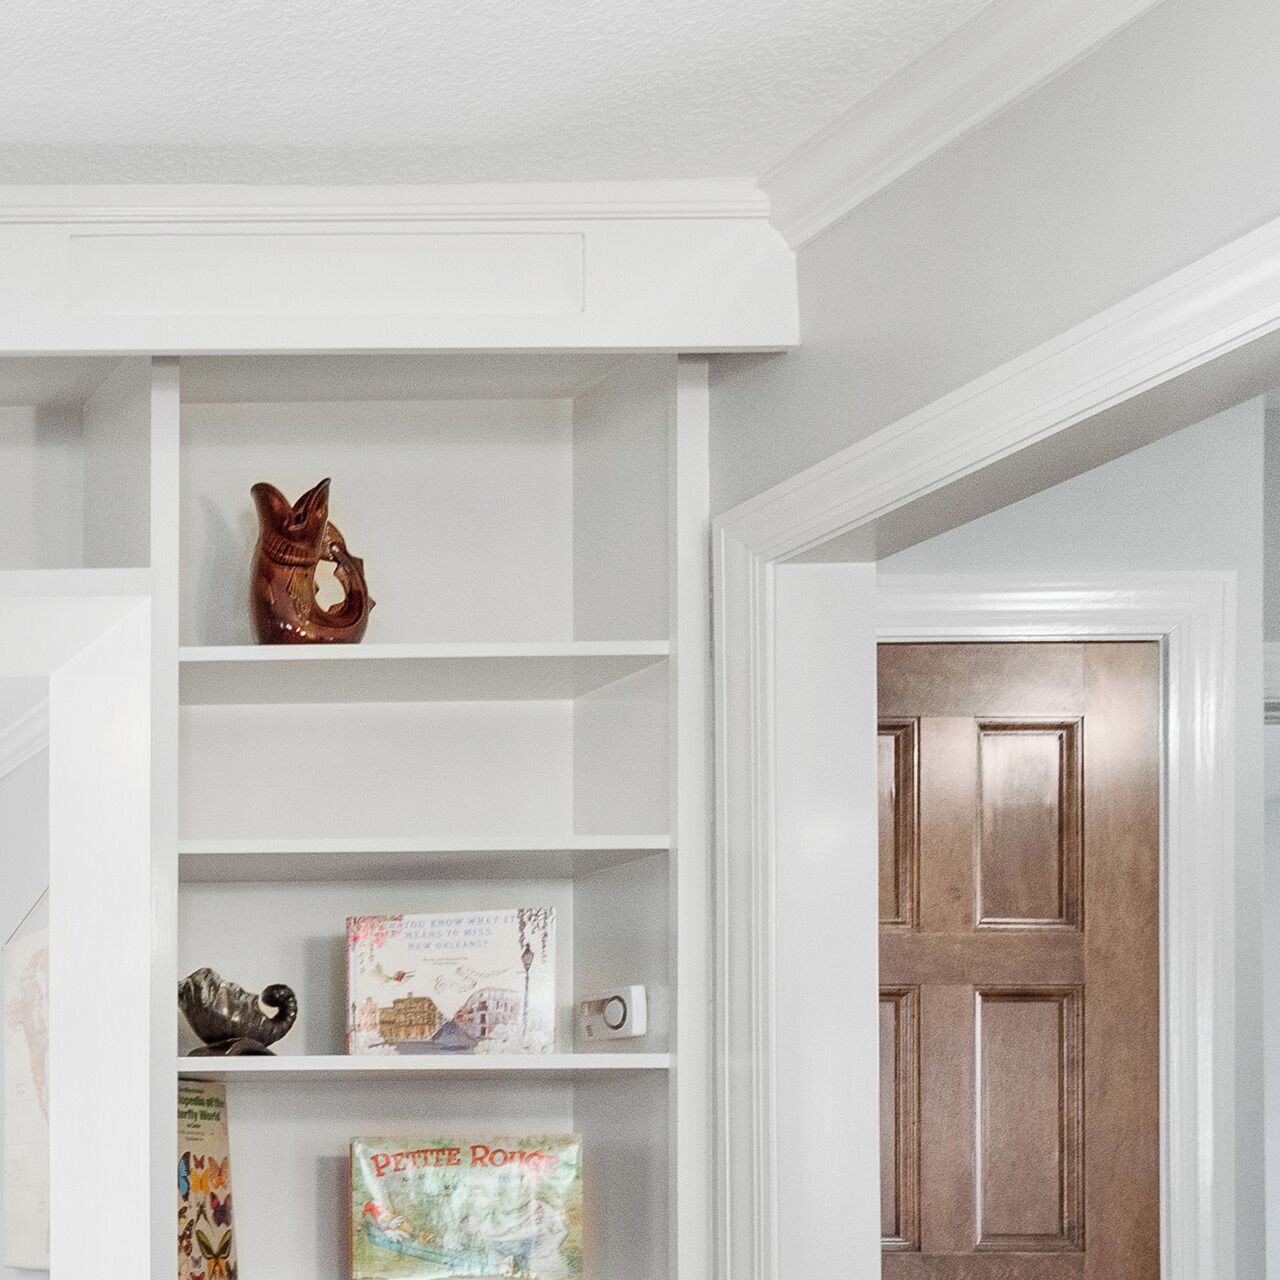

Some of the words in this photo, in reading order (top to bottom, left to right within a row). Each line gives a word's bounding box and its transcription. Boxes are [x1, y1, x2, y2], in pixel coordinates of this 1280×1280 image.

[430, 918, 463, 928] KNOW
[468, 916, 498, 926] WHAT
[405, 930, 441, 940] MEANS
[447, 929, 458, 937] TO
[463, 928, 491, 937] MISS
[408, 942, 431, 951] NEW
[369, 1146, 461, 1177] PETITE
[469, 1144, 560, 1171] ROUGE
